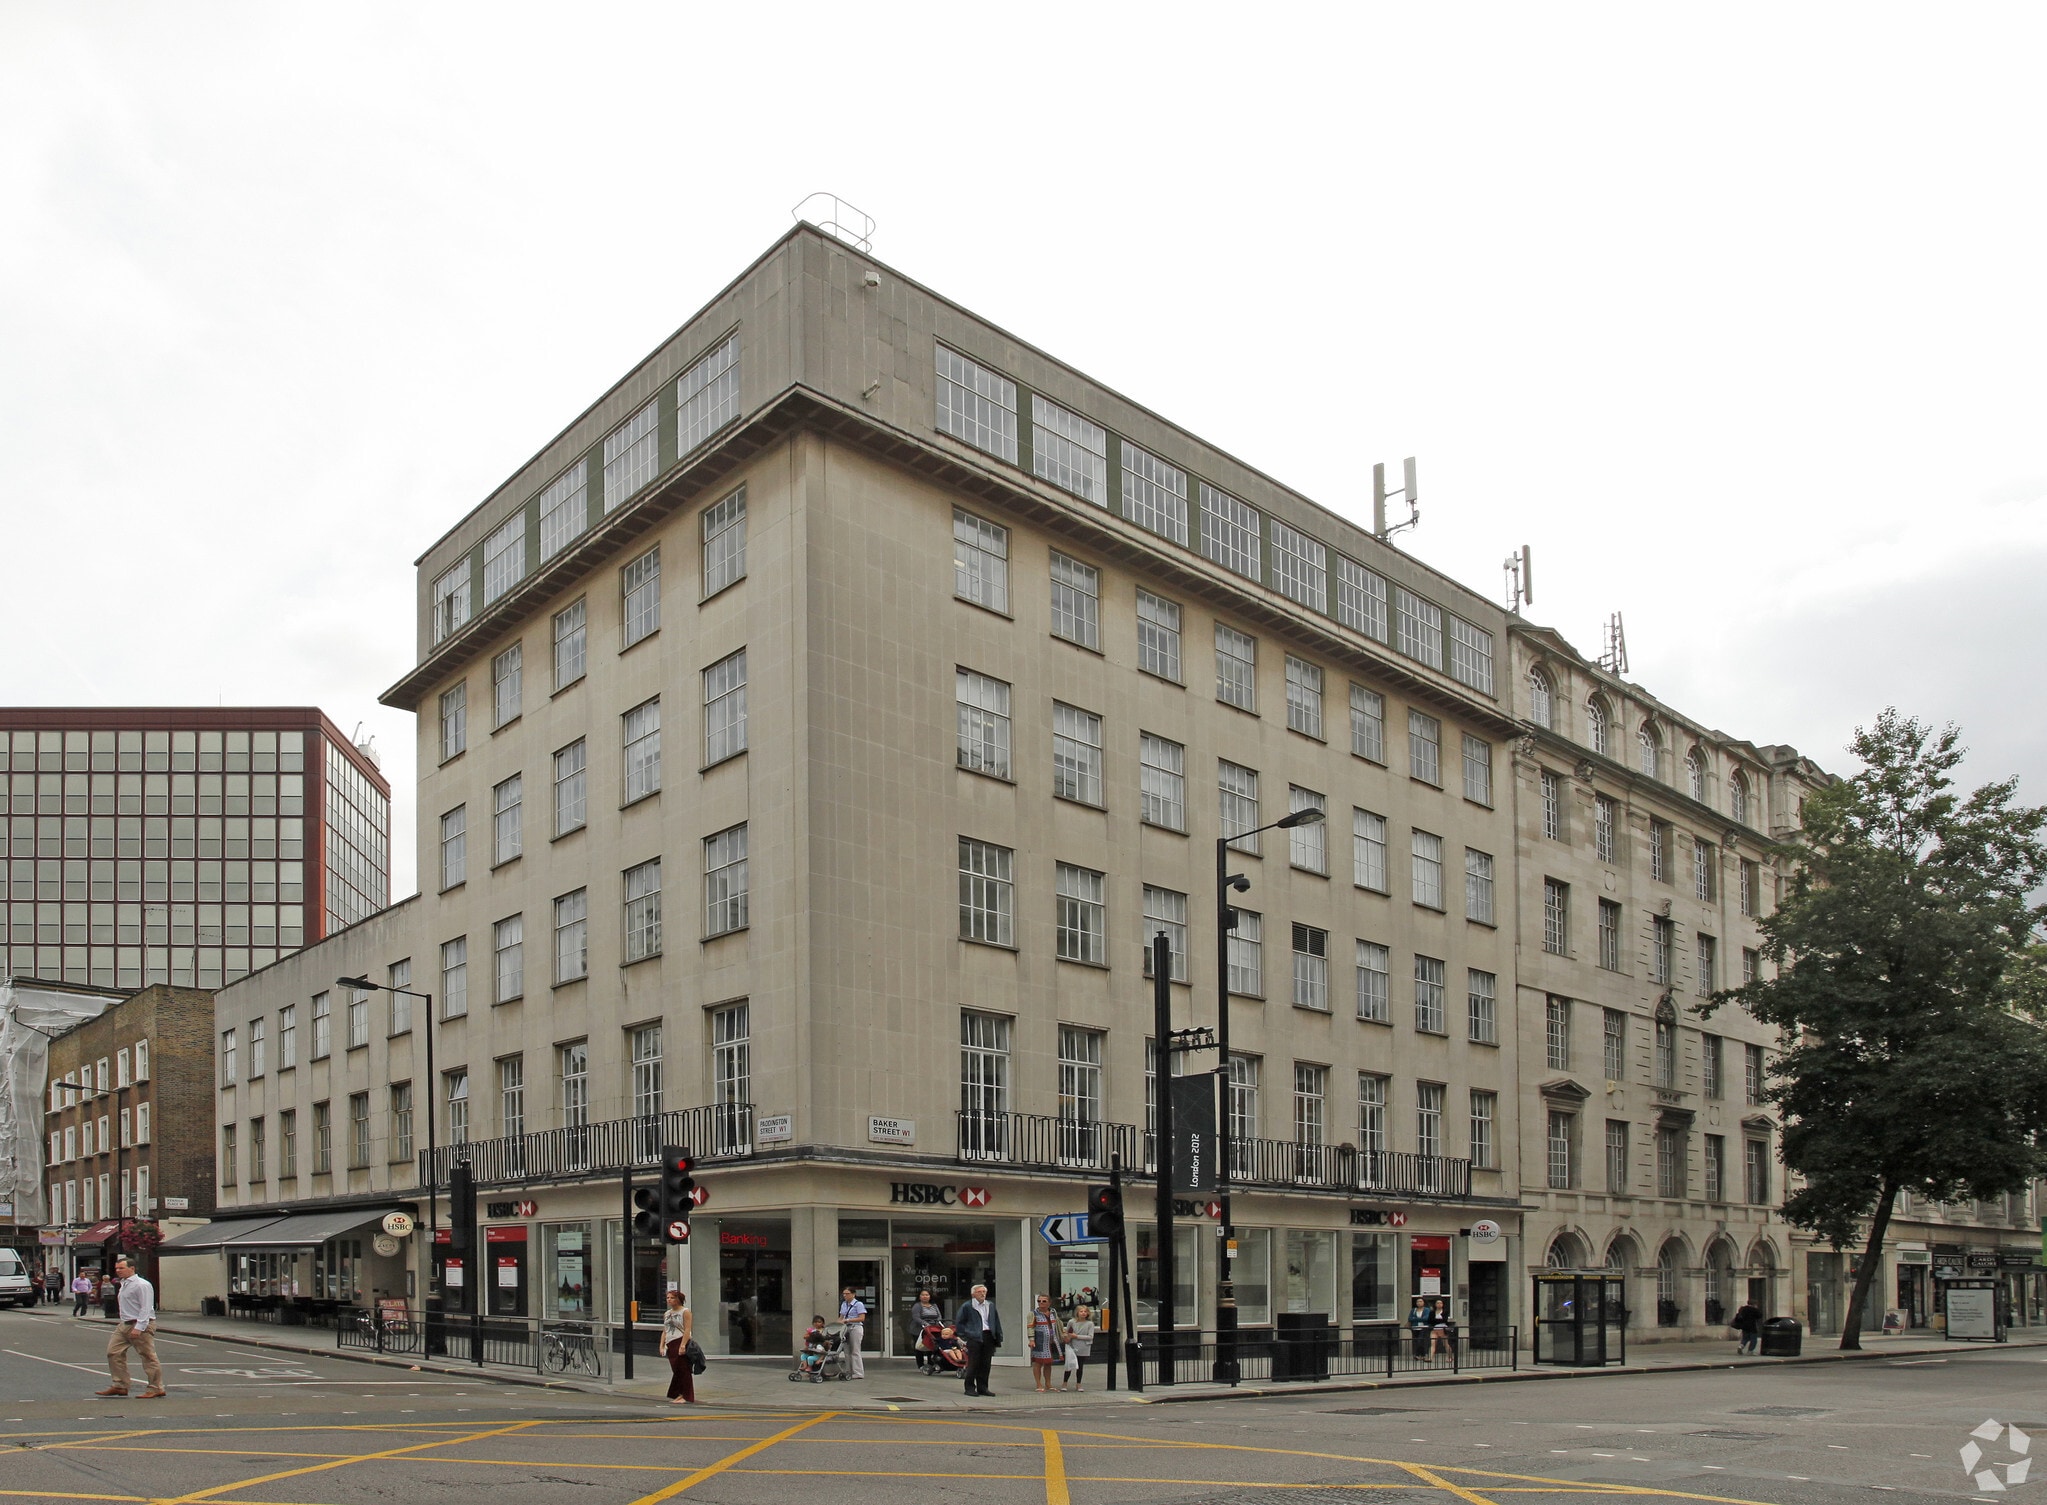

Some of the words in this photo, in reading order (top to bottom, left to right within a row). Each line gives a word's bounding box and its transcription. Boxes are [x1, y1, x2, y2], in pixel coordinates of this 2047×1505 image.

[760, 1118, 788, 1127] PADDINGTON
[873, 1119, 898, 1128] BAKER
[760, 1127, 776, 1135] STREET
[873, 1126, 900, 1136] STREET
[901, 1129, 911, 1137] W1
[1191, 1133, 1200, 1153] 2012
[1190, 1154, 1199, 1188] London
[890, 1182, 957, 1205] HSBC
[487, 1201, 519, 1218] HSBC
[1350, 1209, 1388, 1225] HSBC
[387, 1223, 412, 1231] HSBC
[720, 1231, 768, 1248] Banking
[1472, 1230, 1496, 1238] HSBC
[915, 1274, 948, 1285] open
